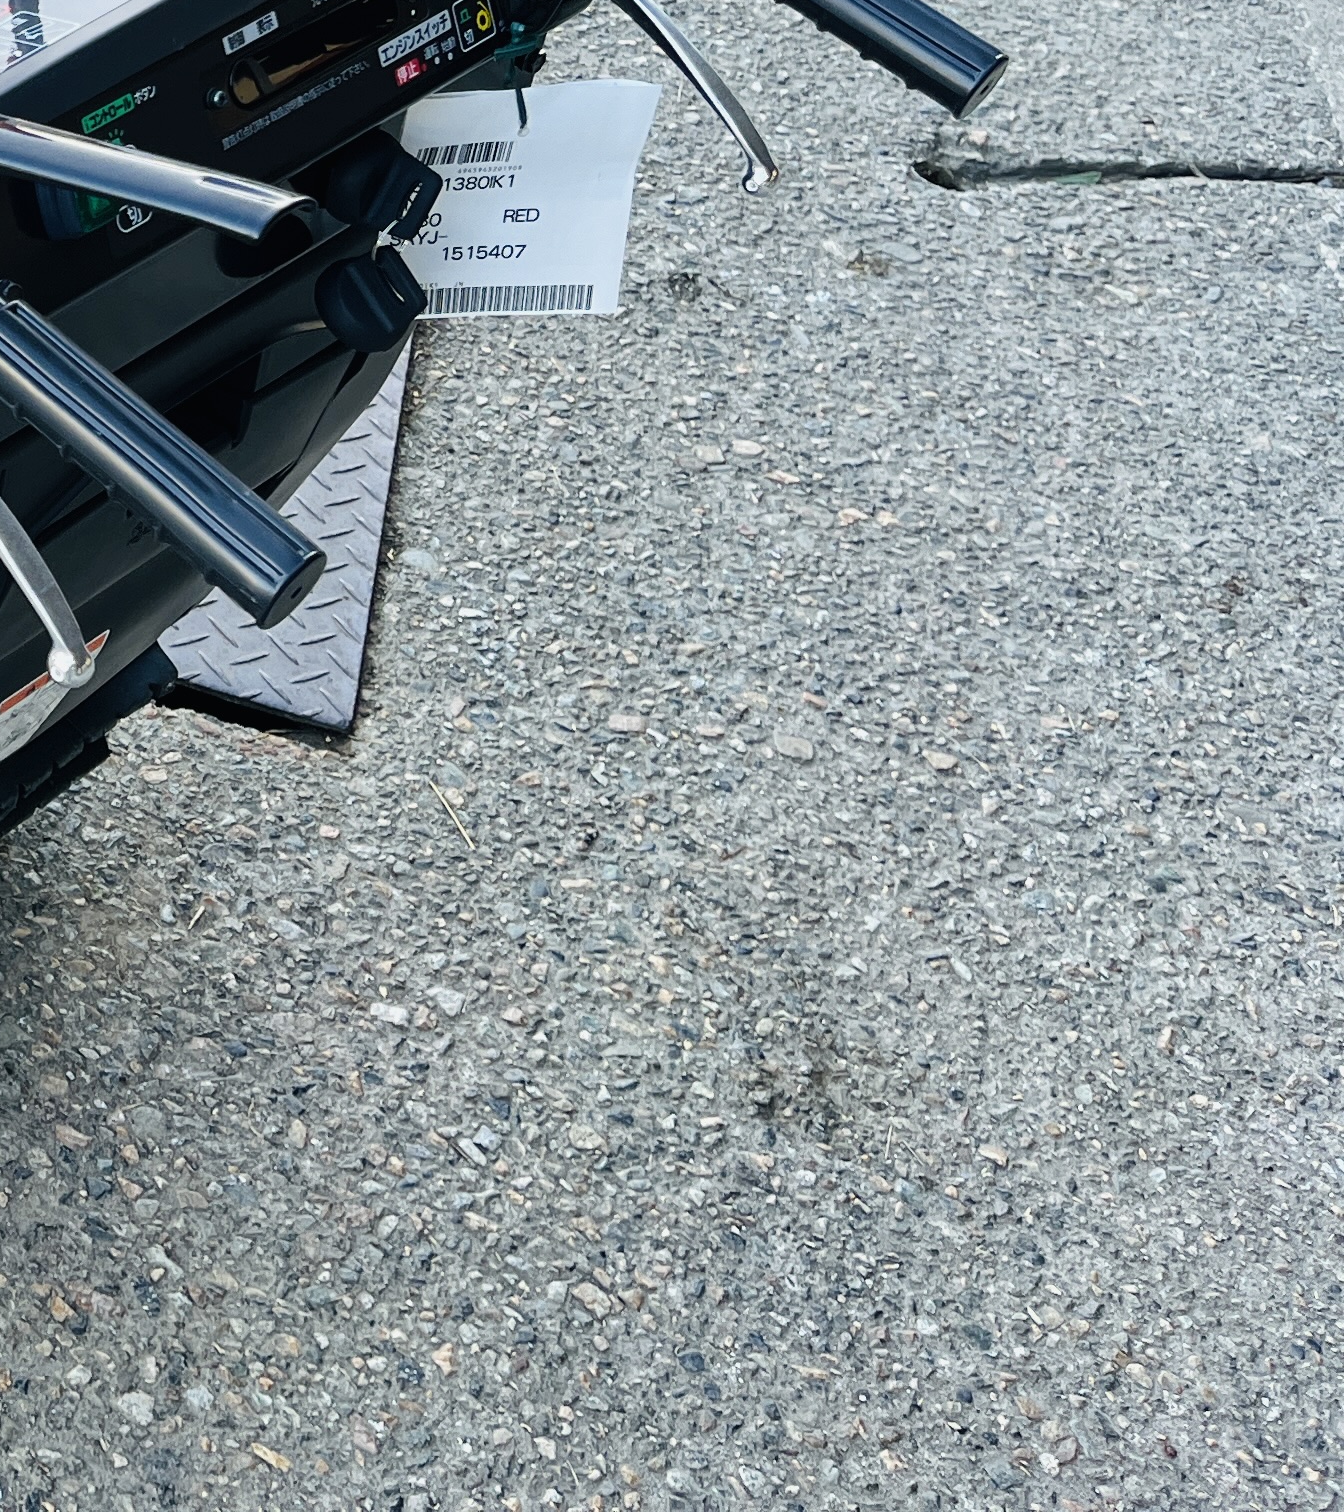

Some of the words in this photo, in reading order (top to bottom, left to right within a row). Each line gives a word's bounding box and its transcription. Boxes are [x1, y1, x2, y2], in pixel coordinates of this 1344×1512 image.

[380, 13, 449, 63] エンジンスイッチ
[397, 60, 420, 83] 停止
[502, 208, 540, 224] RED
[442, 244, 527, 261] 1515407
